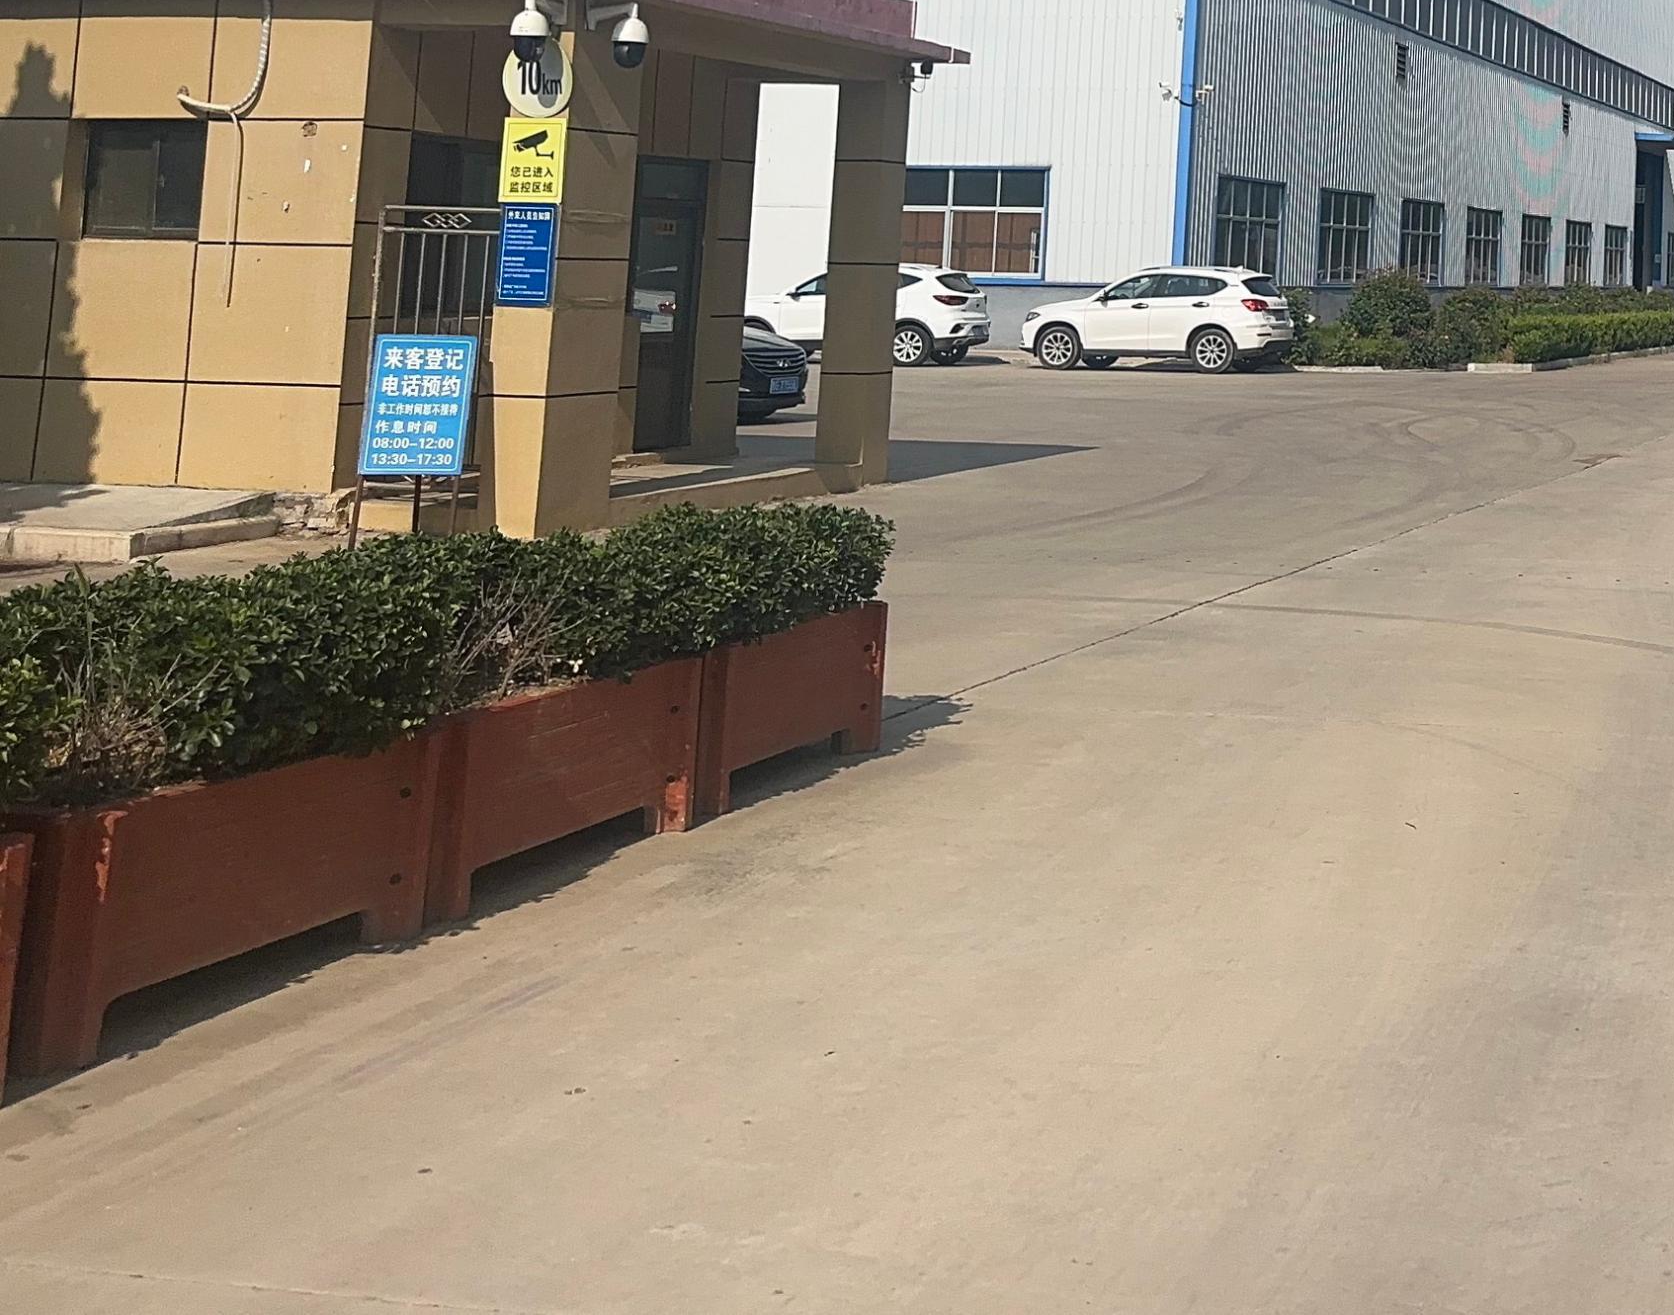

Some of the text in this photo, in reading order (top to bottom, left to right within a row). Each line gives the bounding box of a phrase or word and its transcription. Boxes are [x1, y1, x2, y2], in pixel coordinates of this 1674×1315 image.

[517, 60, 562, 95] 10km
[510, 166, 554, 178] 您已进入
[509, 181, 553, 193] 监控区域
[383, 346, 465, 370] 来客登记
[381, 374, 462, 397] 电话预约
[377, 402, 459, 417] 非工作时间恕不接待
[375, 420, 438, 435] 作息时间
